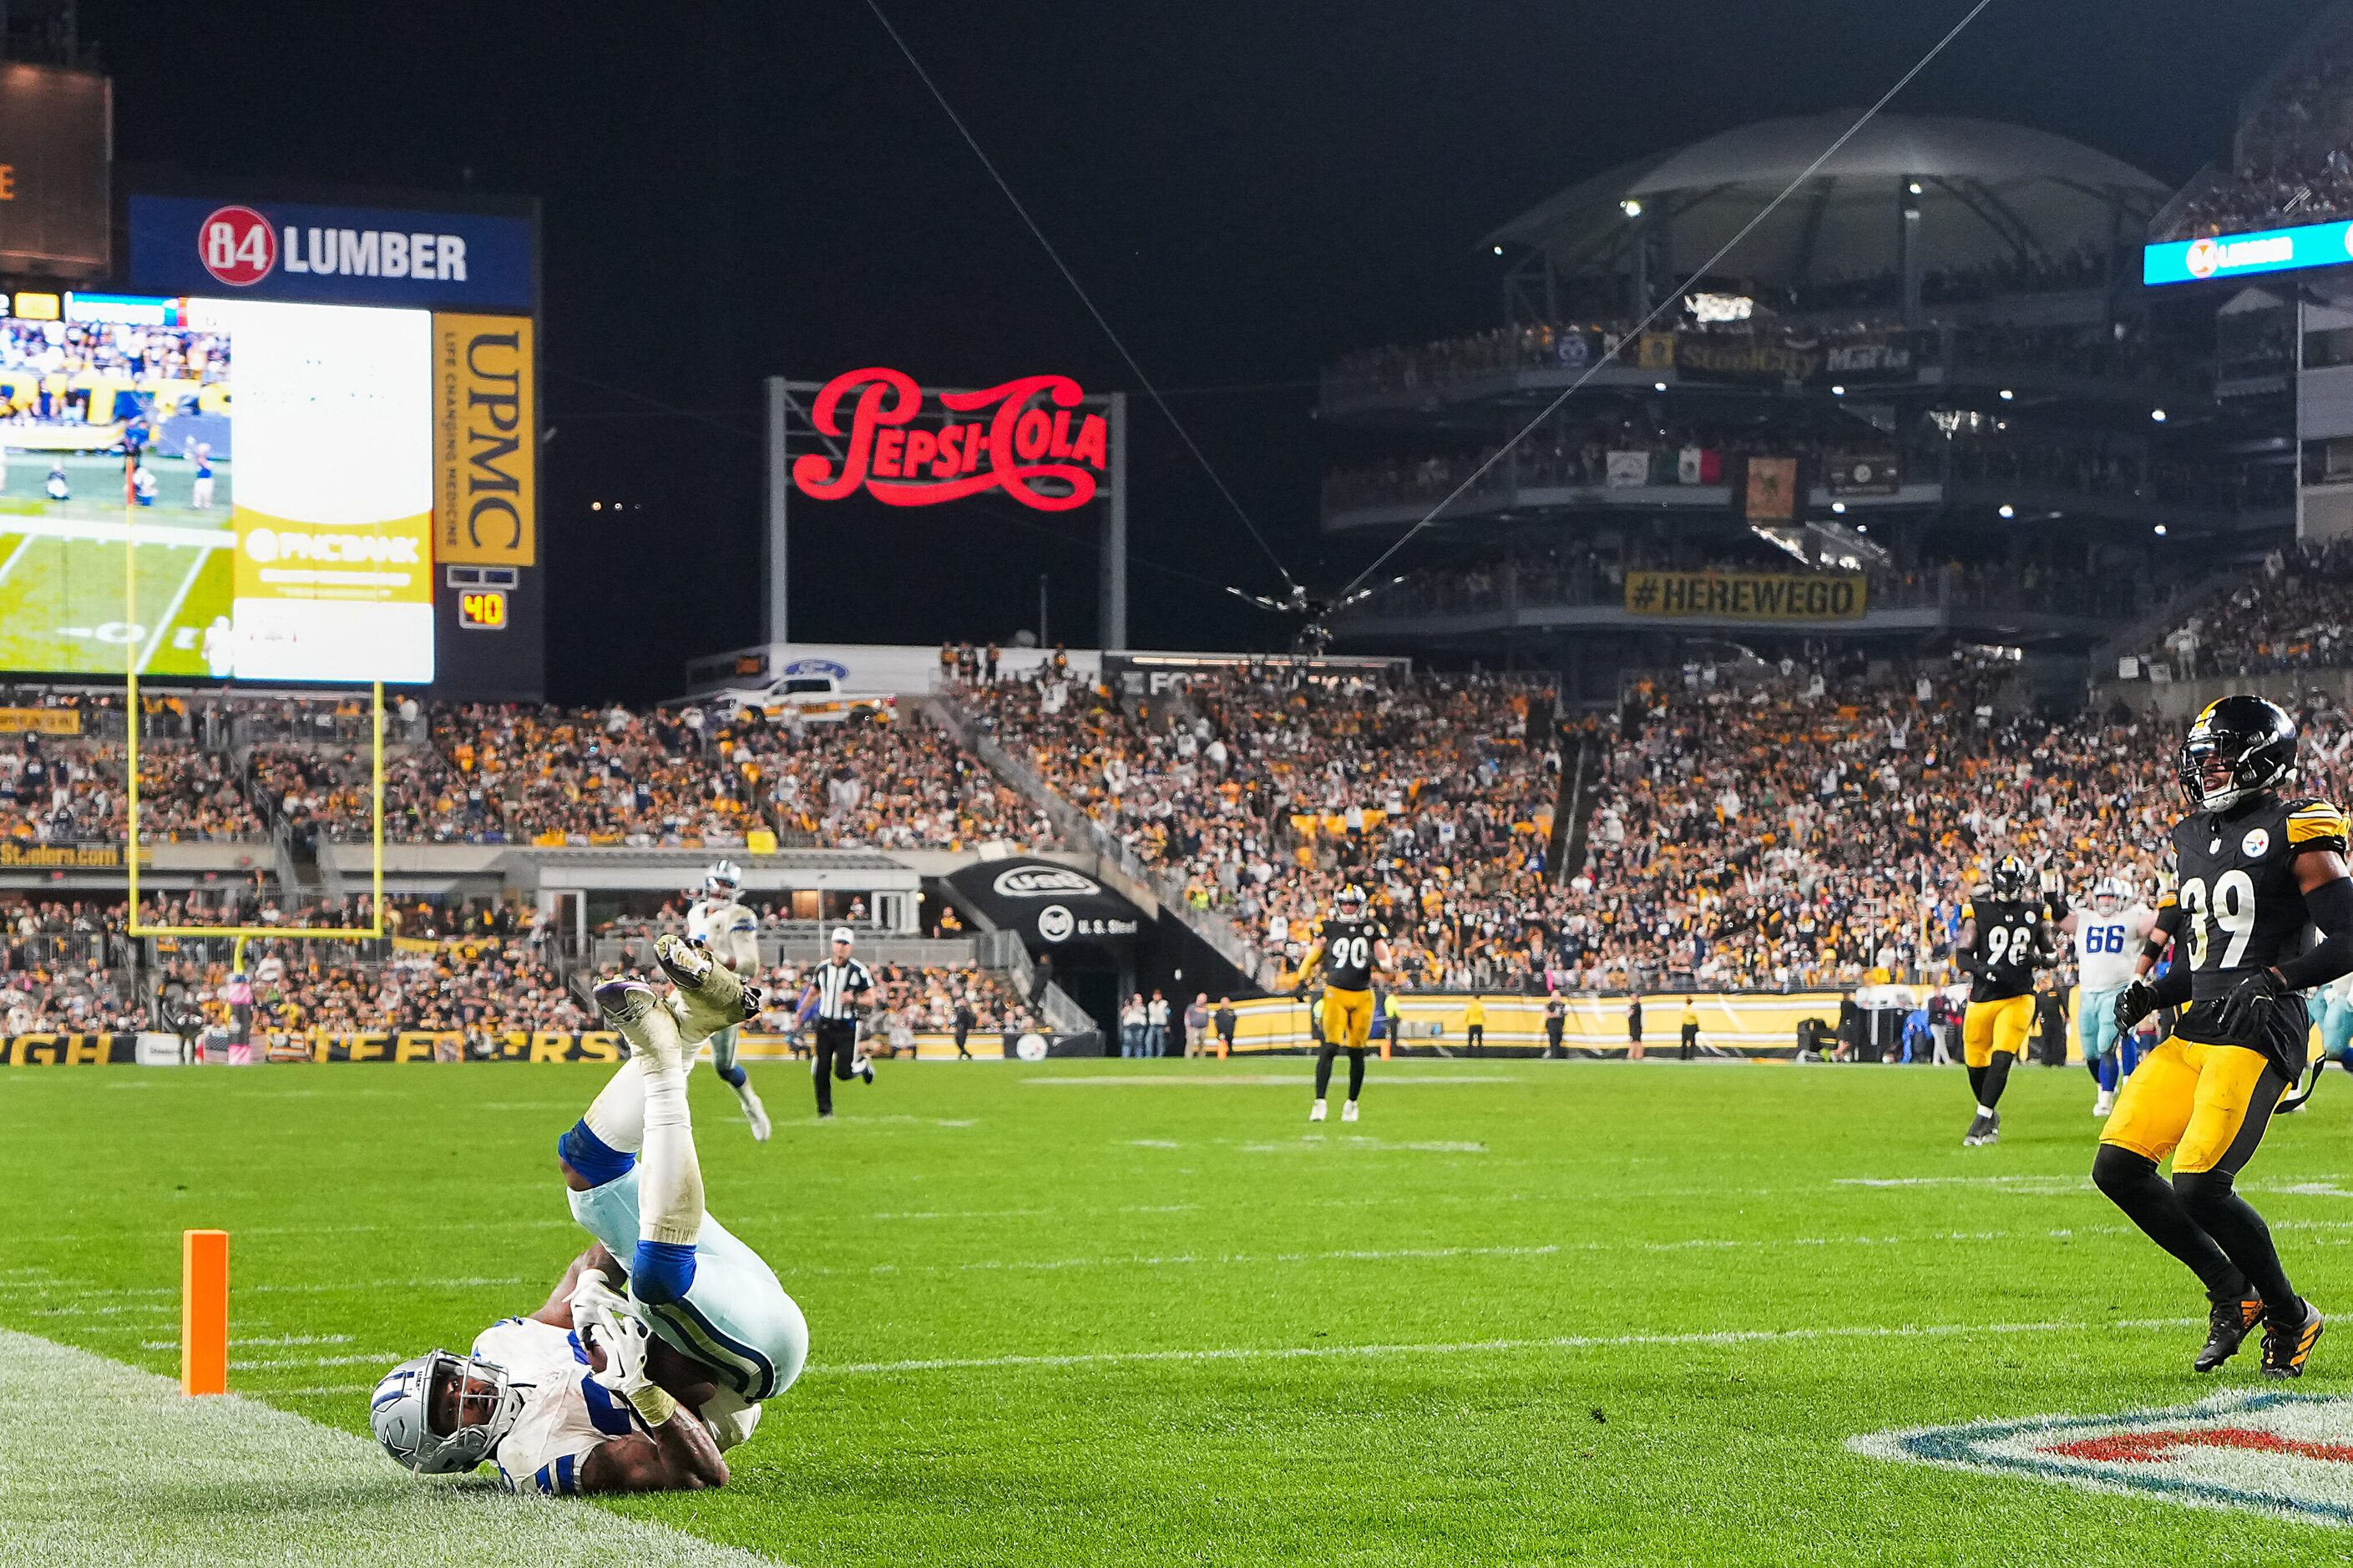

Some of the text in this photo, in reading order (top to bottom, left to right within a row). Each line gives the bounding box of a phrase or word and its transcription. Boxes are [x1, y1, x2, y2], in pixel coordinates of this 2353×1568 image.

[208, 221, 468, 281] 84 LUMBER
[444, 331, 457, 366] LIFE
[467, 331, 522, 549] UPMC
[446, 467, 458, 548] MEDICINE
[463, 593, 503, 625] 40
[1632, 577, 1854, 615] #HEREWEGO
[2086, 924, 2126, 953] 66
[2179, 868, 2256, 973] 39
[1332, 936, 1369, 969] 90
[0, 1032, 112, 1066] GH
